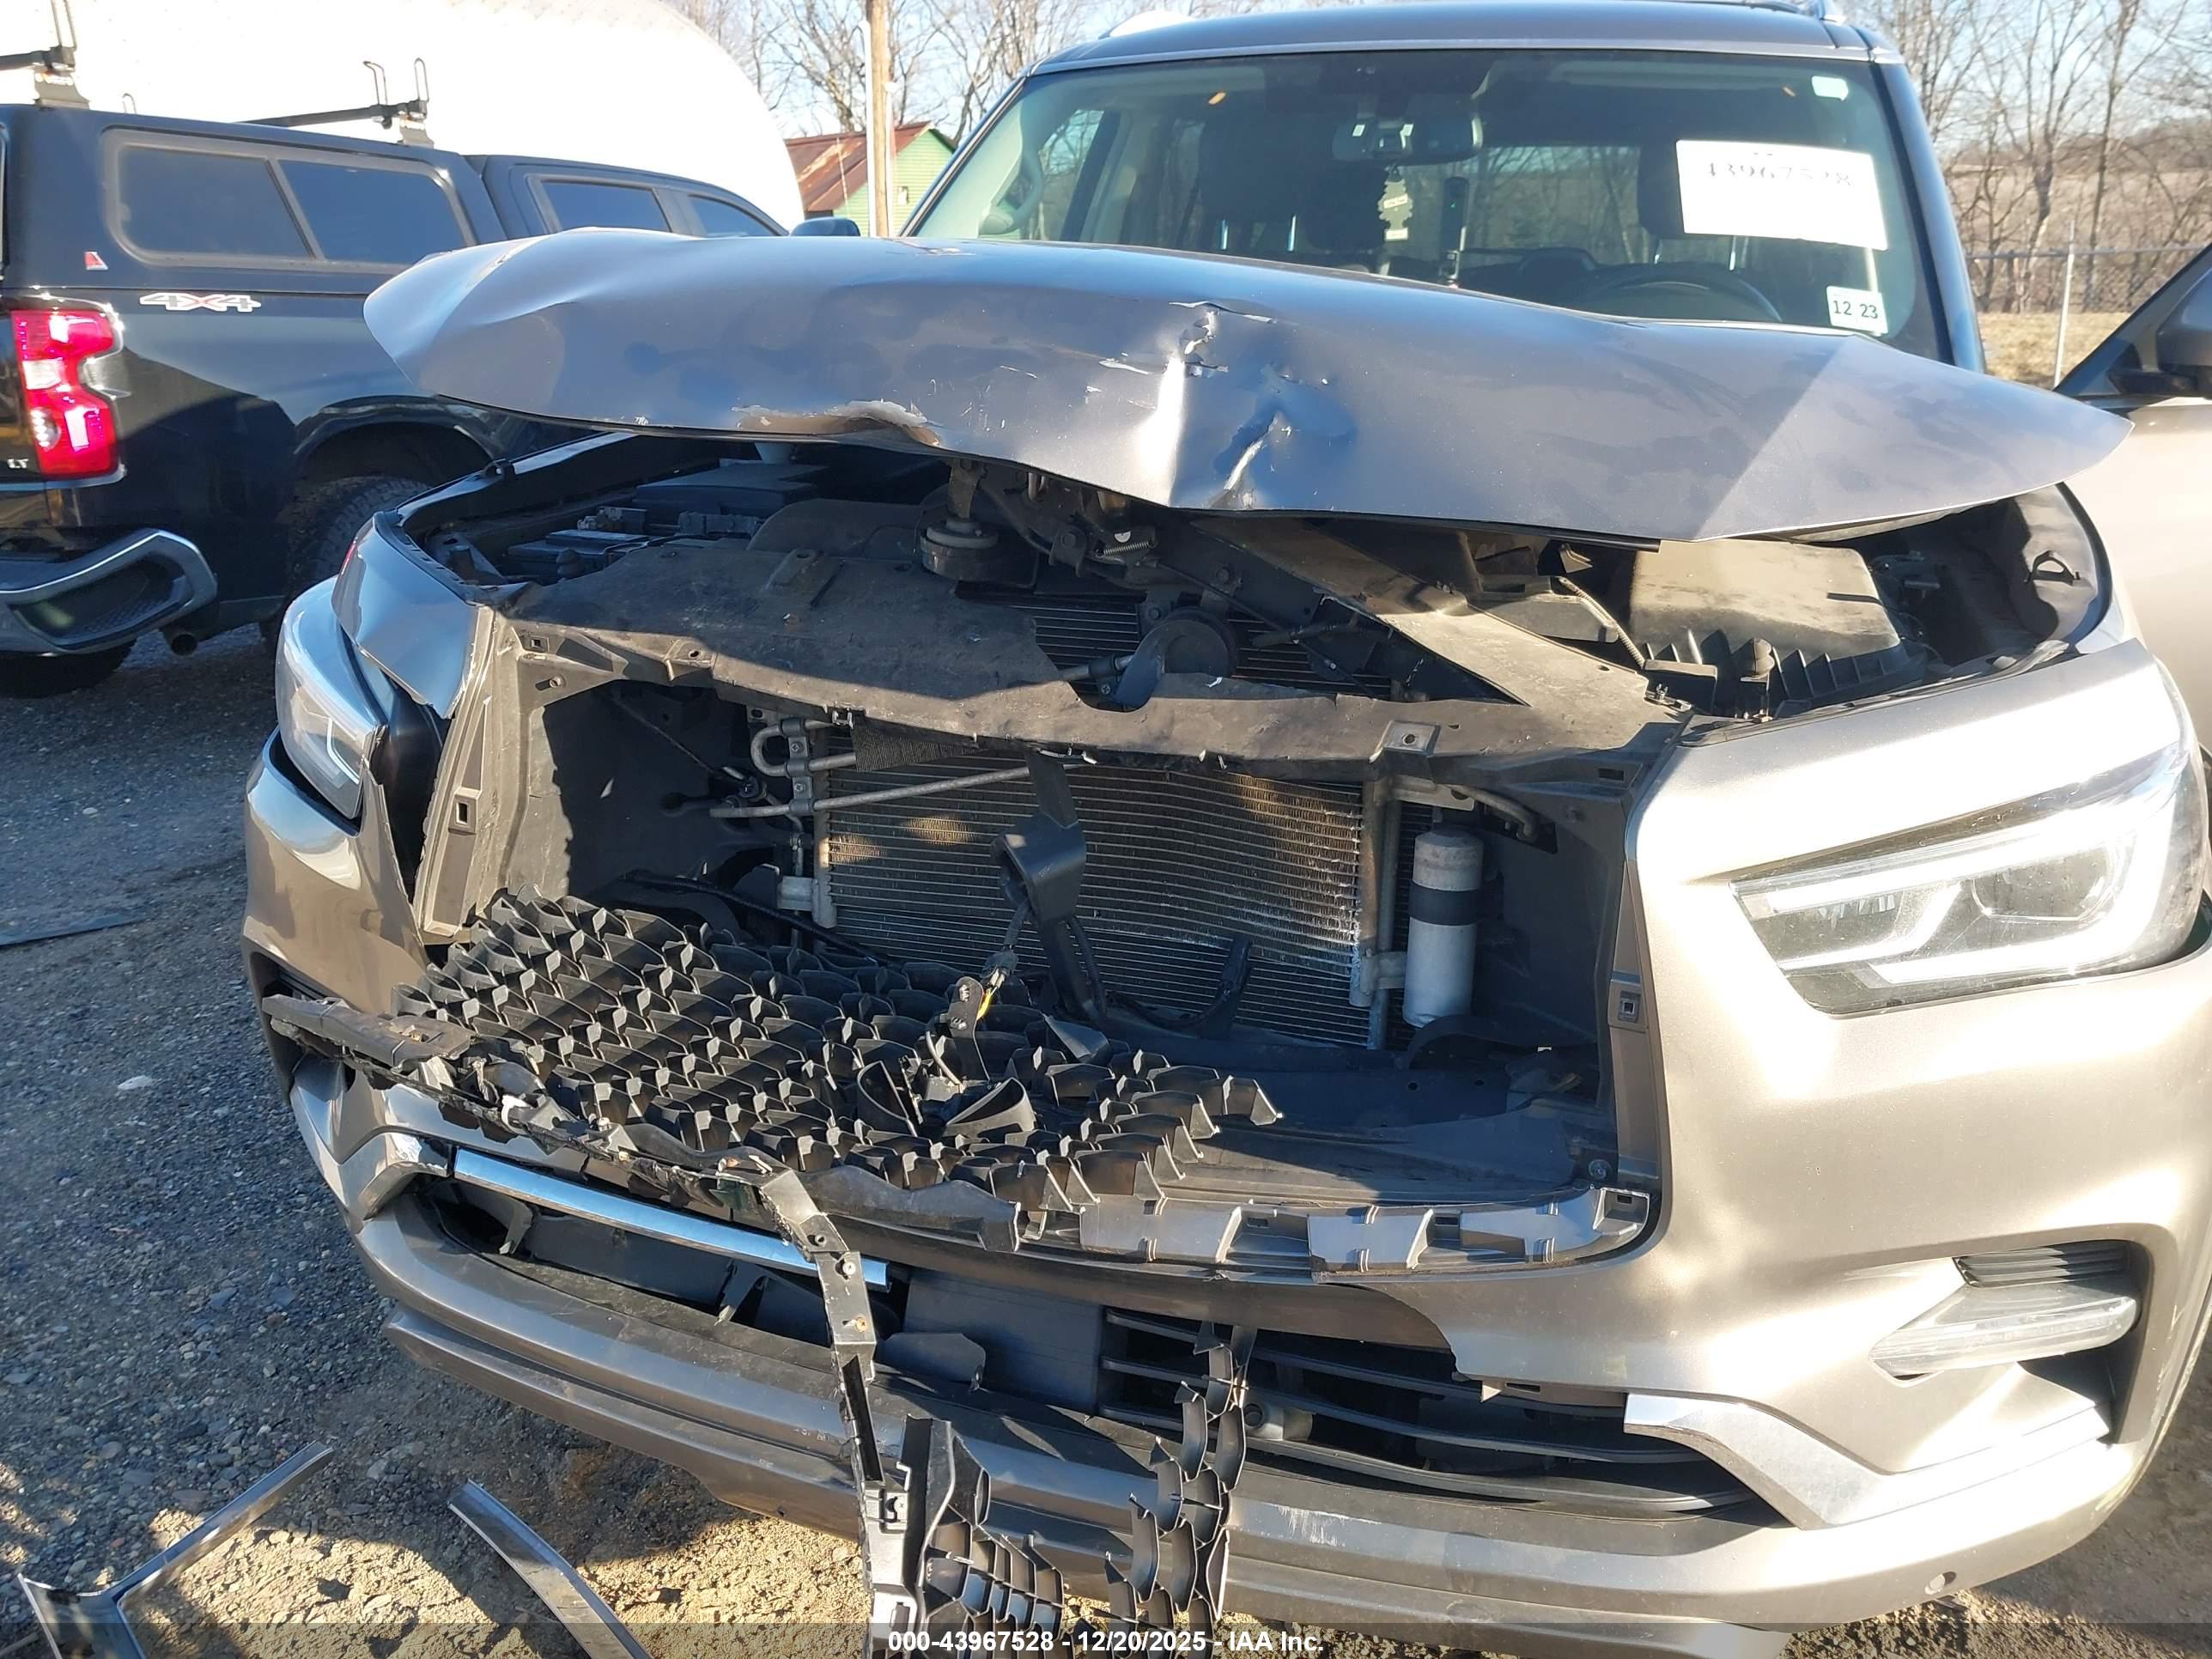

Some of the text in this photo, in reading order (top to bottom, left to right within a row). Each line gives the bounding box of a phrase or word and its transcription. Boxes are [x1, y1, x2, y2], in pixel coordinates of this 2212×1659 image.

[1832, 300, 1879, 319] 12 23
[7, 459, 29, 469] LT
